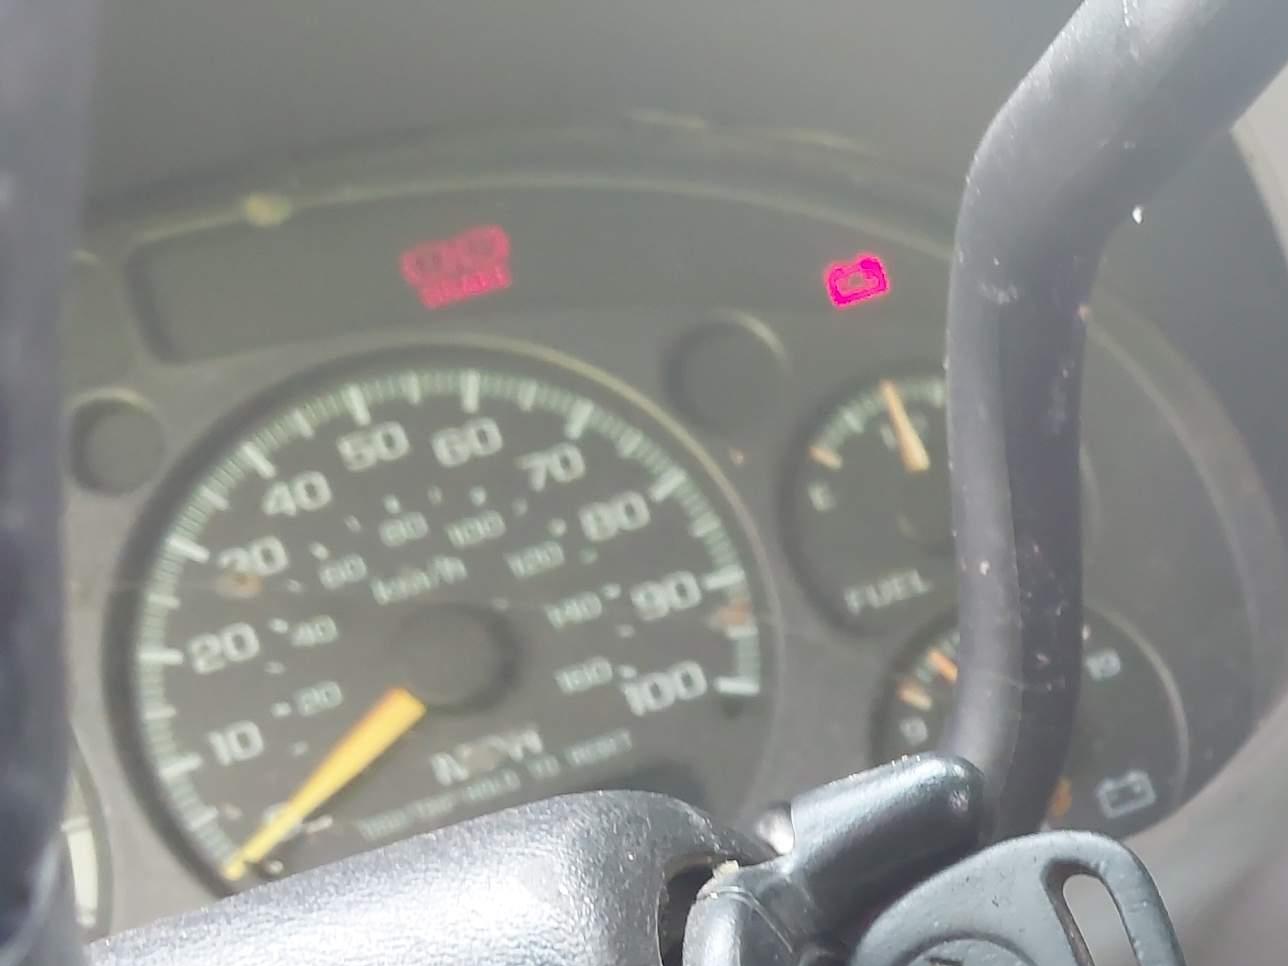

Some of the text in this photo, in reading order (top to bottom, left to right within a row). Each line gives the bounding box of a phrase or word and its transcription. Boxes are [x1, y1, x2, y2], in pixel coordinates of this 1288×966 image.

[336, 420, 409, 472] 50
[432, 417, 503, 468] 60
[514, 442, 586, 491] 70
[261, 469, 332, 517] 40
[579, 491, 650, 541] 80
[630, 571, 701, 621] 90
[187, 622, 260, 674] 20
[622, 661, 707, 717] 100
[207, 720, 264, 765] 10
